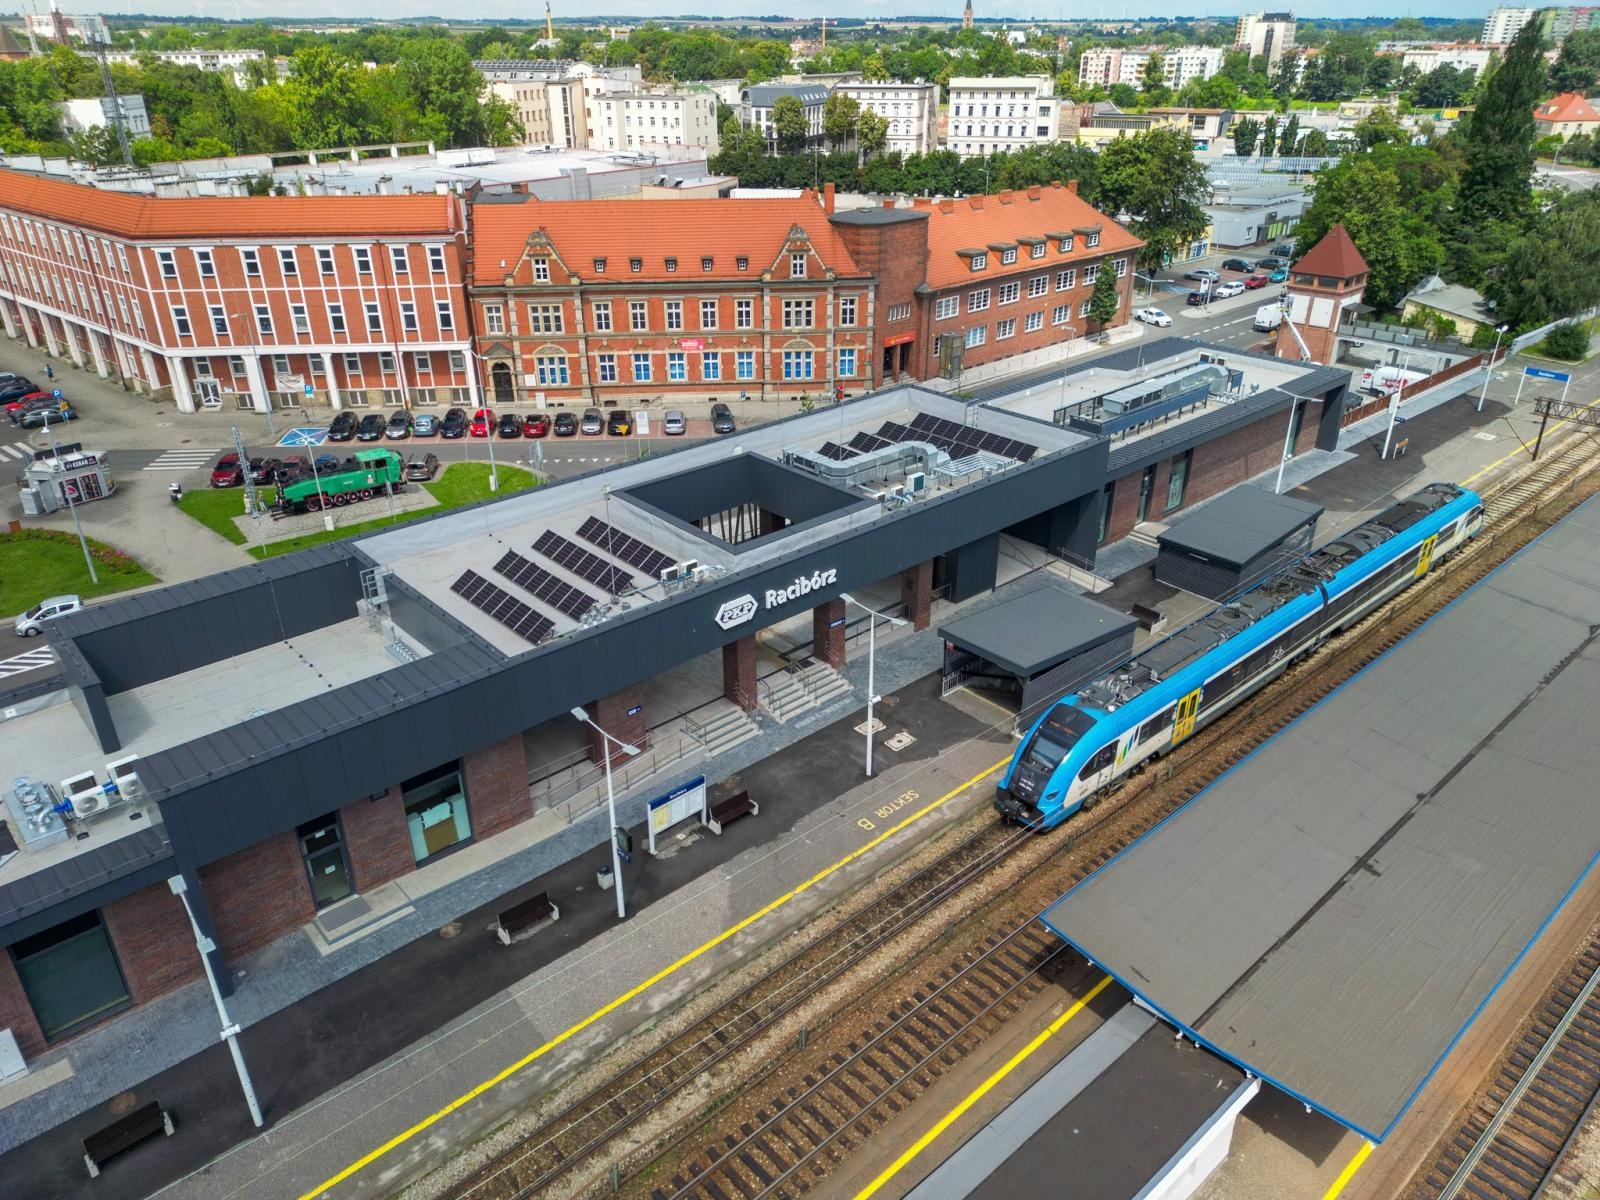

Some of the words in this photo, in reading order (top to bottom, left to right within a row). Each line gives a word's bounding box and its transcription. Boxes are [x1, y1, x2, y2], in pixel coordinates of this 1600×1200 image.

[722, 602, 754, 623] PKP
[765, 568, 837, 609] Racibórz
[874, 790, 920, 818] SEKTOR
[857, 817, 876, 831] B
